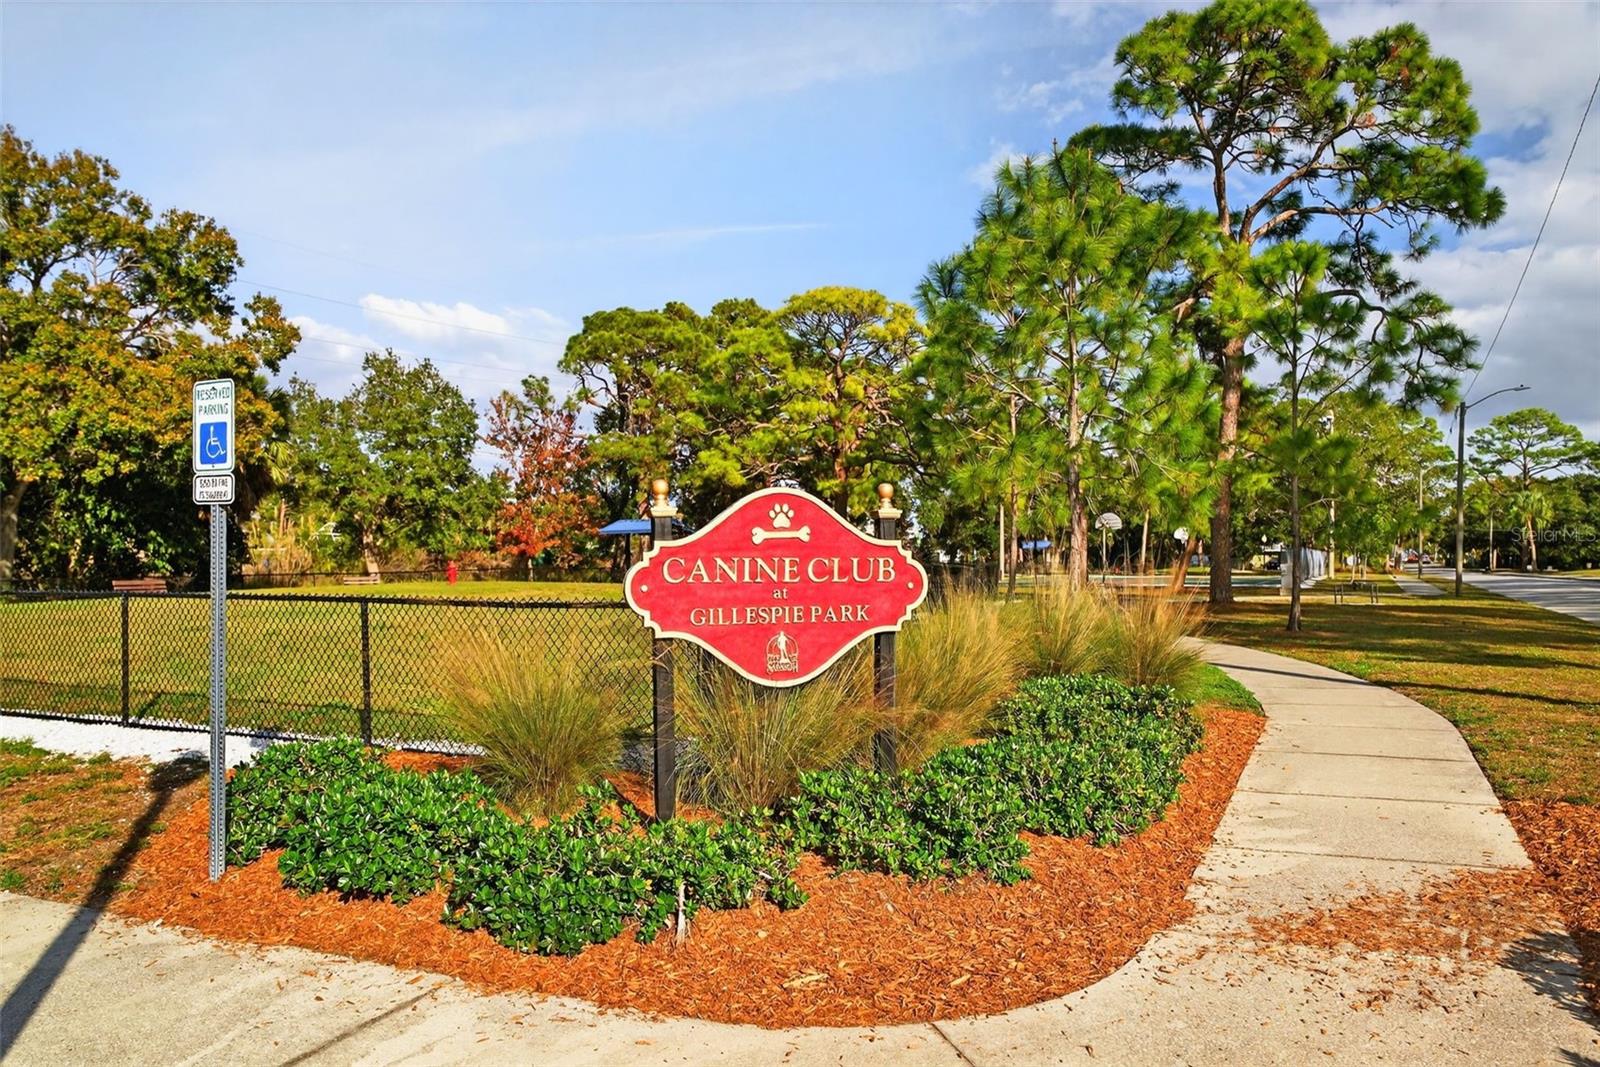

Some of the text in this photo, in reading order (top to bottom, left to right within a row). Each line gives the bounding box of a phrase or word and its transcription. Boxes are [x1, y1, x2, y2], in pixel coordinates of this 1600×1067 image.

[199, 402, 229, 415] PARKING
[661, 556, 896, 584] CANINE CLUB
[773, 588, 788, 600] at
[690, 604, 869, 626] GILLESPIE PARK
